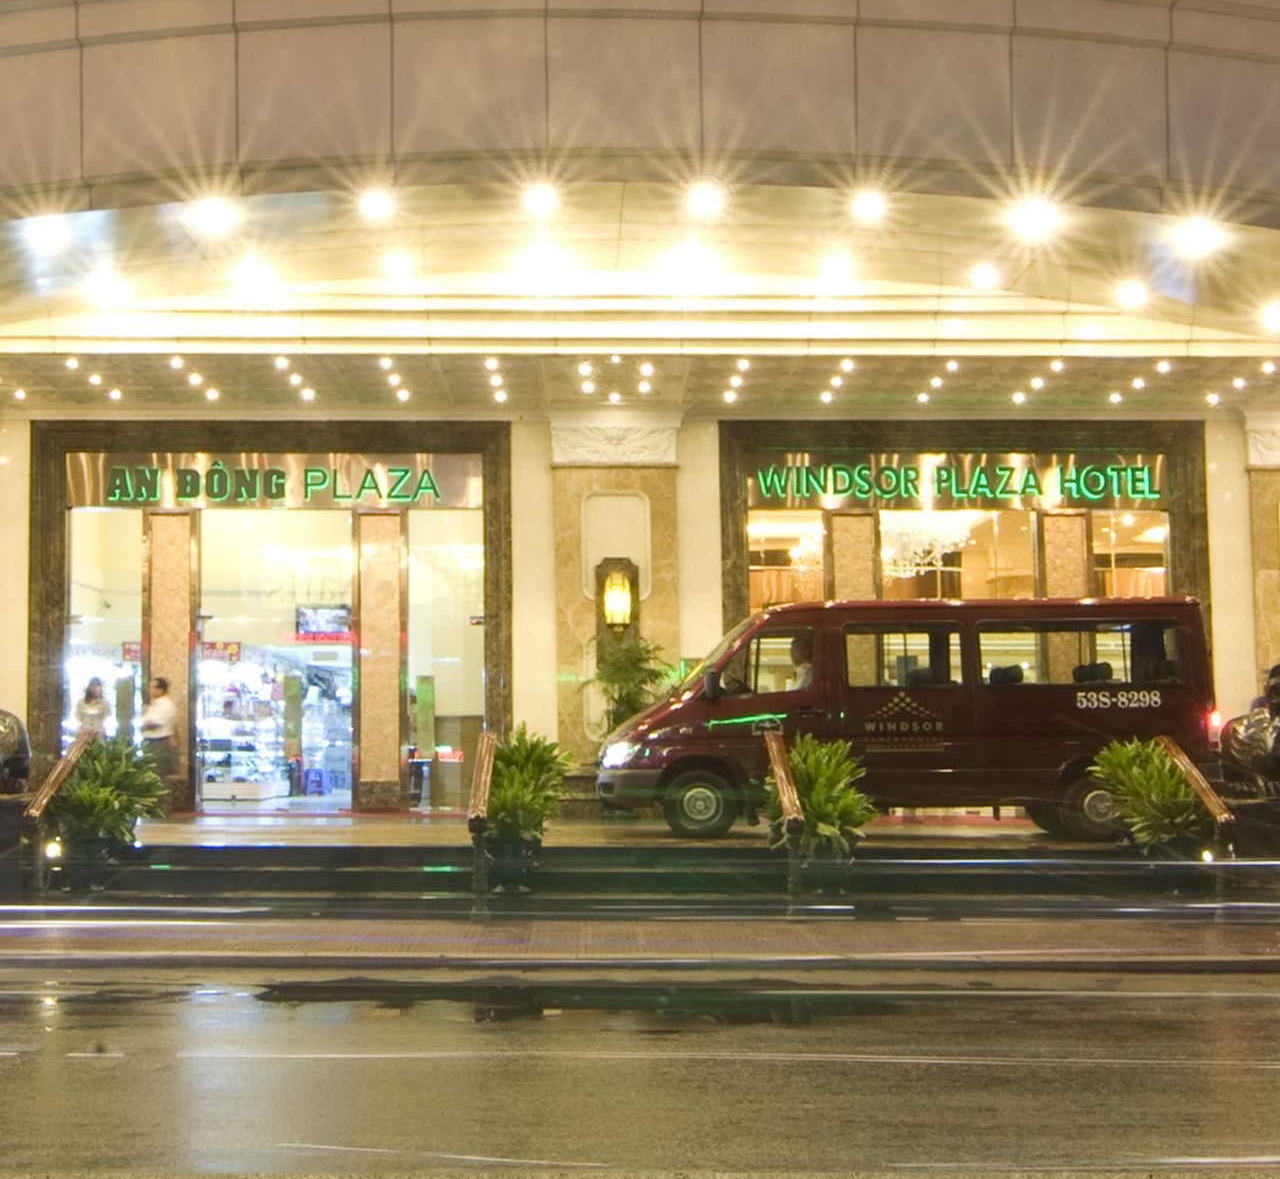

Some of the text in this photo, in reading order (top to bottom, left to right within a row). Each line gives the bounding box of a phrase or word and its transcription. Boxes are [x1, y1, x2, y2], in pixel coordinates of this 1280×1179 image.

[107, 468, 161, 501] AN
[303, 468, 442, 502] PLAZA
[757, 464, 1161, 500] WINDSOR PLAZA HOTEL
[1075, 691, 1162, 710] 53S-8298
[863, 721, 944, 732] WINDSOR
